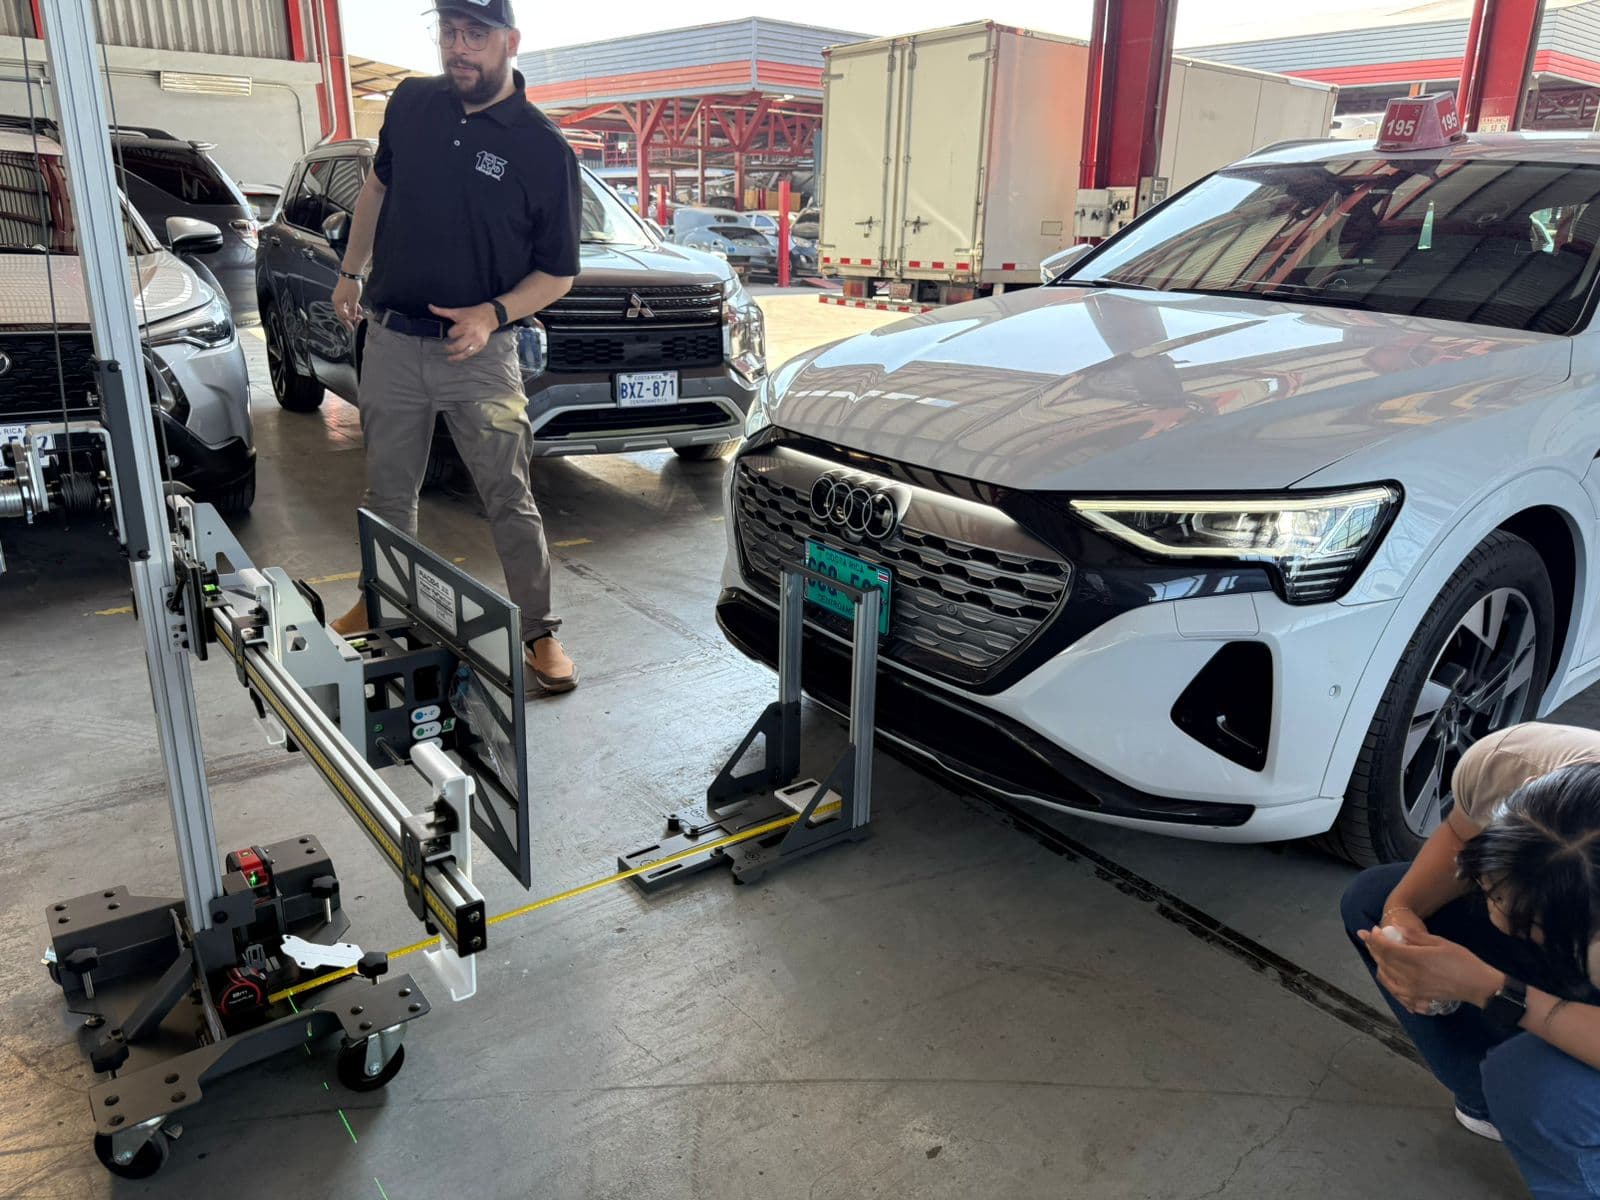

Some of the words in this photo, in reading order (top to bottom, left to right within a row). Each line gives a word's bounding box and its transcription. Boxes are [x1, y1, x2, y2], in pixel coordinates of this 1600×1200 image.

[1386, 119, 1416, 137] 195
[1441, 111, 1458, 132] 195
[620, 380, 674, 399] BXZ-871
[826, 550, 848, 567] COSTA
[848, 561, 865, 575] RICA
